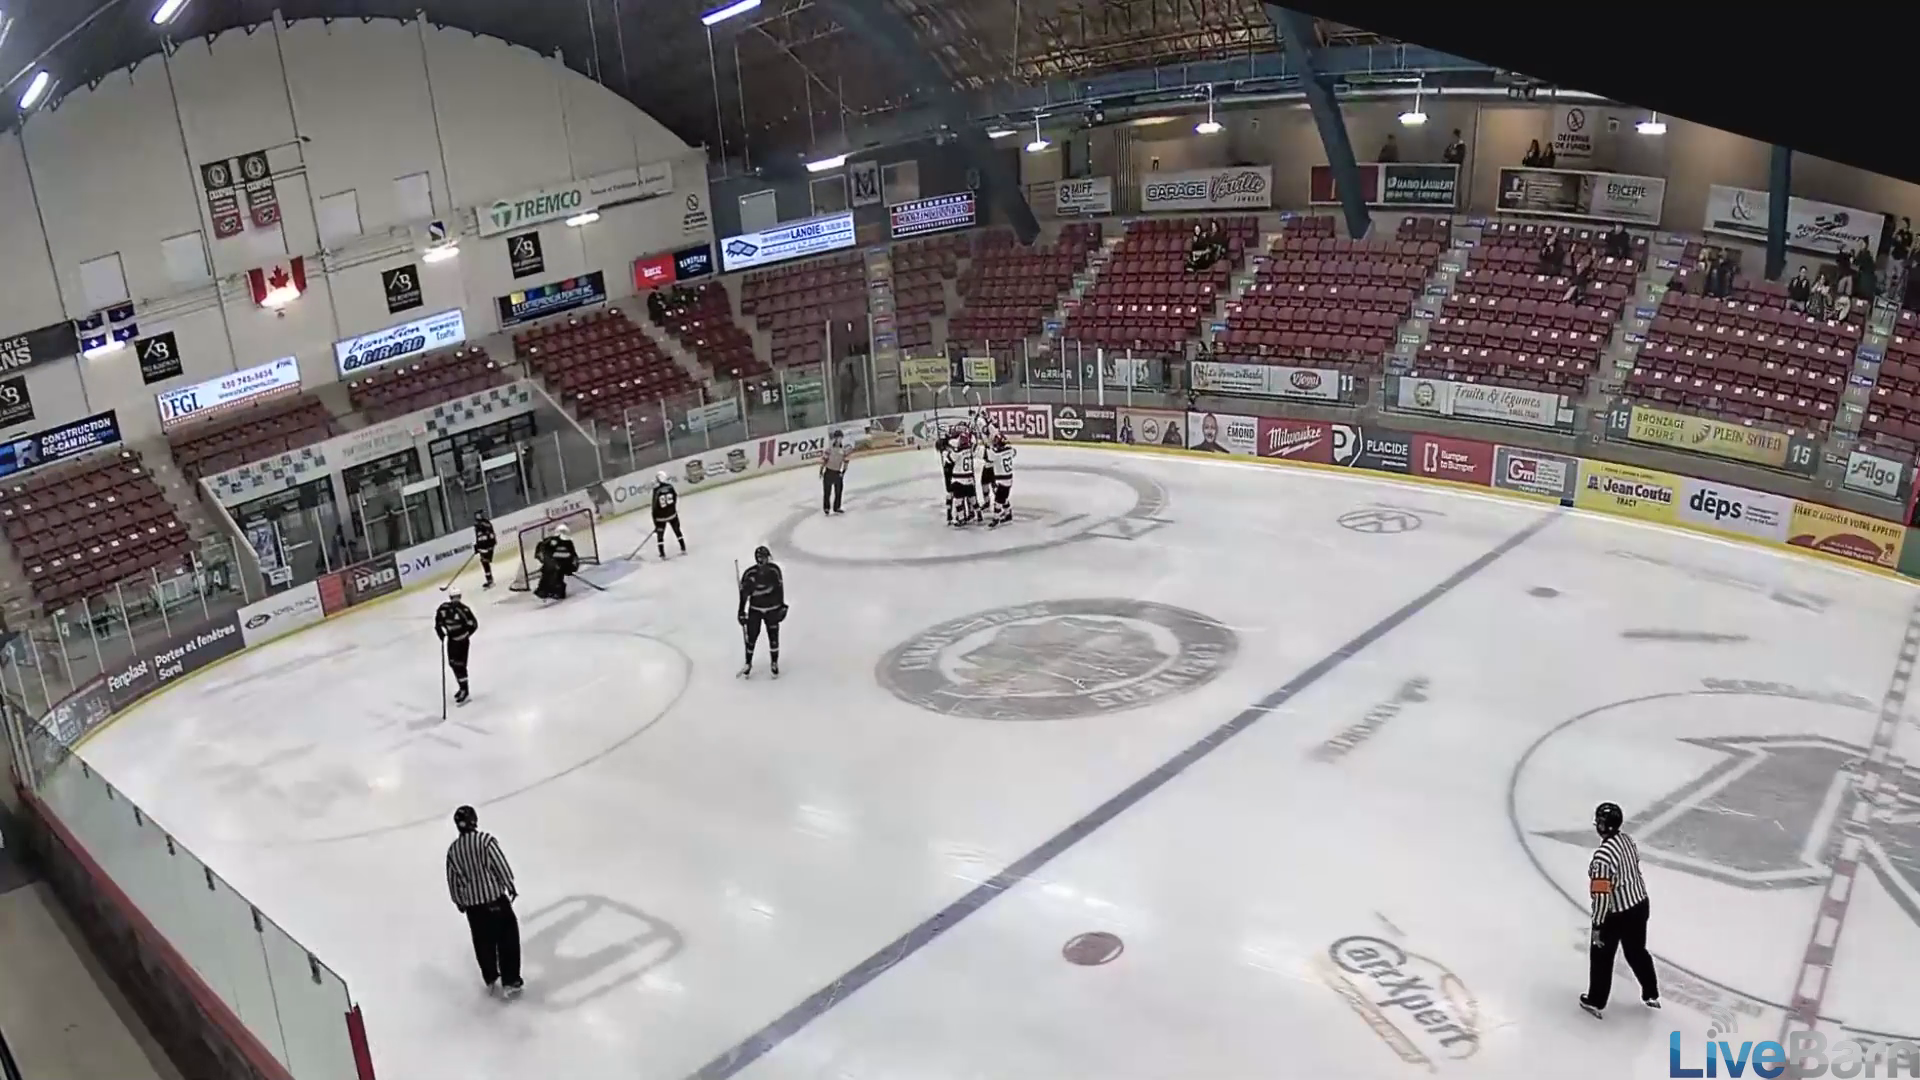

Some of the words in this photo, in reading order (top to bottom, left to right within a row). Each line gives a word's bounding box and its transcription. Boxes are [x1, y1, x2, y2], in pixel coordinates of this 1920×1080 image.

[1146, 181, 1207, 202] GARAGE
[514, 189, 582, 222] TREMCO
[1086, 363, 1094, 379] 9
[1340, 374, 1353, 391] 11
[169, 391, 204, 417] FGL
[1487, 388, 1498, 404] &
[1610, 409, 1629, 430] 15
[1637, 412, 1685, 430] BRONZAGE
[41, 417, 112, 446] CONSTRUCTION
[1227, 425, 1255, 440] ÉMOND
[1266, 424, 1322, 450] Milwaukee
[1642, 426, 1674, 441] JOURS
[1712, 426, 1745, 443] PLEIN
[1366, 439, 1409, 456] PLACIDE
[1441, 450, 1469, 462] Bumper
[1792, 443, 1811, 465] 15
[1440, 459, 1447, 468] to
[1602, 478, 1633, 496] Jean
[1634, 483, 1672, 503] Coutu
[154, 645, 185, 668] Portes
[185, 640, 197, 653] et
[197, 623, 236, 648] fenêtres
[107, 660, 149, 693] Fenplast
[158, 660, 184, 681] Sorel
